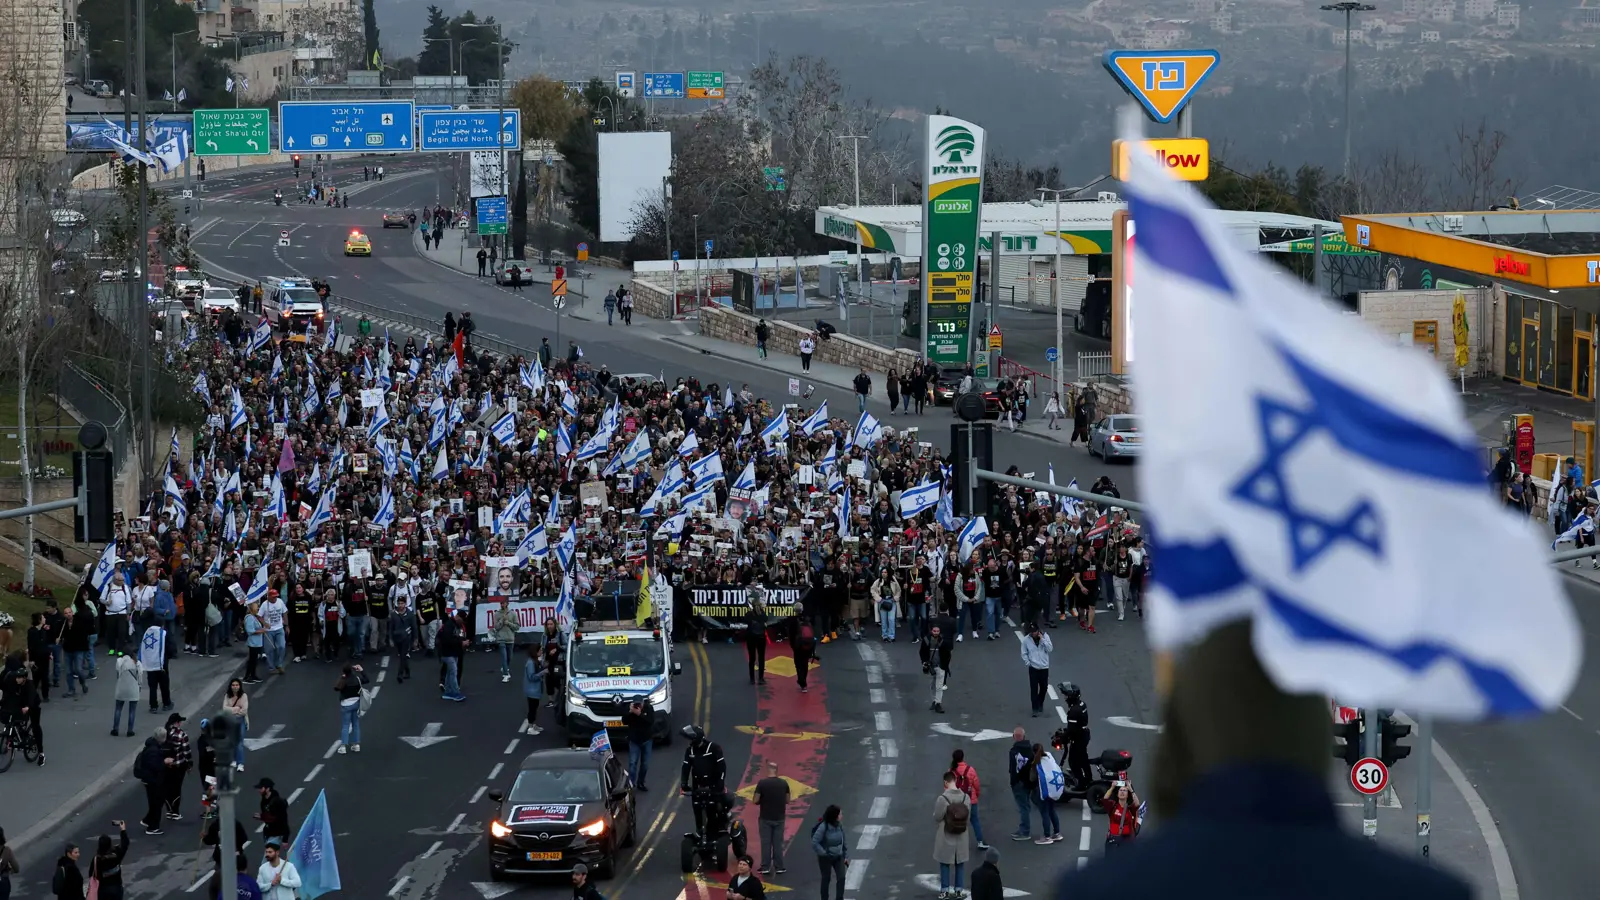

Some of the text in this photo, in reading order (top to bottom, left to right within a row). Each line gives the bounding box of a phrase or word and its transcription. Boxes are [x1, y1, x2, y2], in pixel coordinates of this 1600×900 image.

[1141, 60, 1186, 91] פז
[353, 106, 364, 115] תל
[200, 112, 220, 120] שאול
[435, 119, 451, 128] צפון
[453, 119, 467, 127] בגין
[427, 136, 449, 144] Begin
[451, 135, 469, 143] Blvd
[1148, 150, 1201, 168] llow
[932, 165, 978, 176] דור אלון
[937, 201, 968, 211] אלונית
[1356, 224, 1370, 247] פז
[999, 235, 1038, 252] דור
[1493, 253, 1530, 276] yellow
[1587, 260, 1600, 283] ז
[956, 273, 970, 281] סולר
[956, 287, 970, 296] סולר
[957, 304, 967, 313] 95
[957, 319, 967, 328] 95
[691, 589, 719, 605] ביחד
[762, 588, 800, 605] ישראל
[692, 606, 728, 617] החטופים
[612, 679, 631, 687] אותם
[1359, 768, 1381, 785] 30
